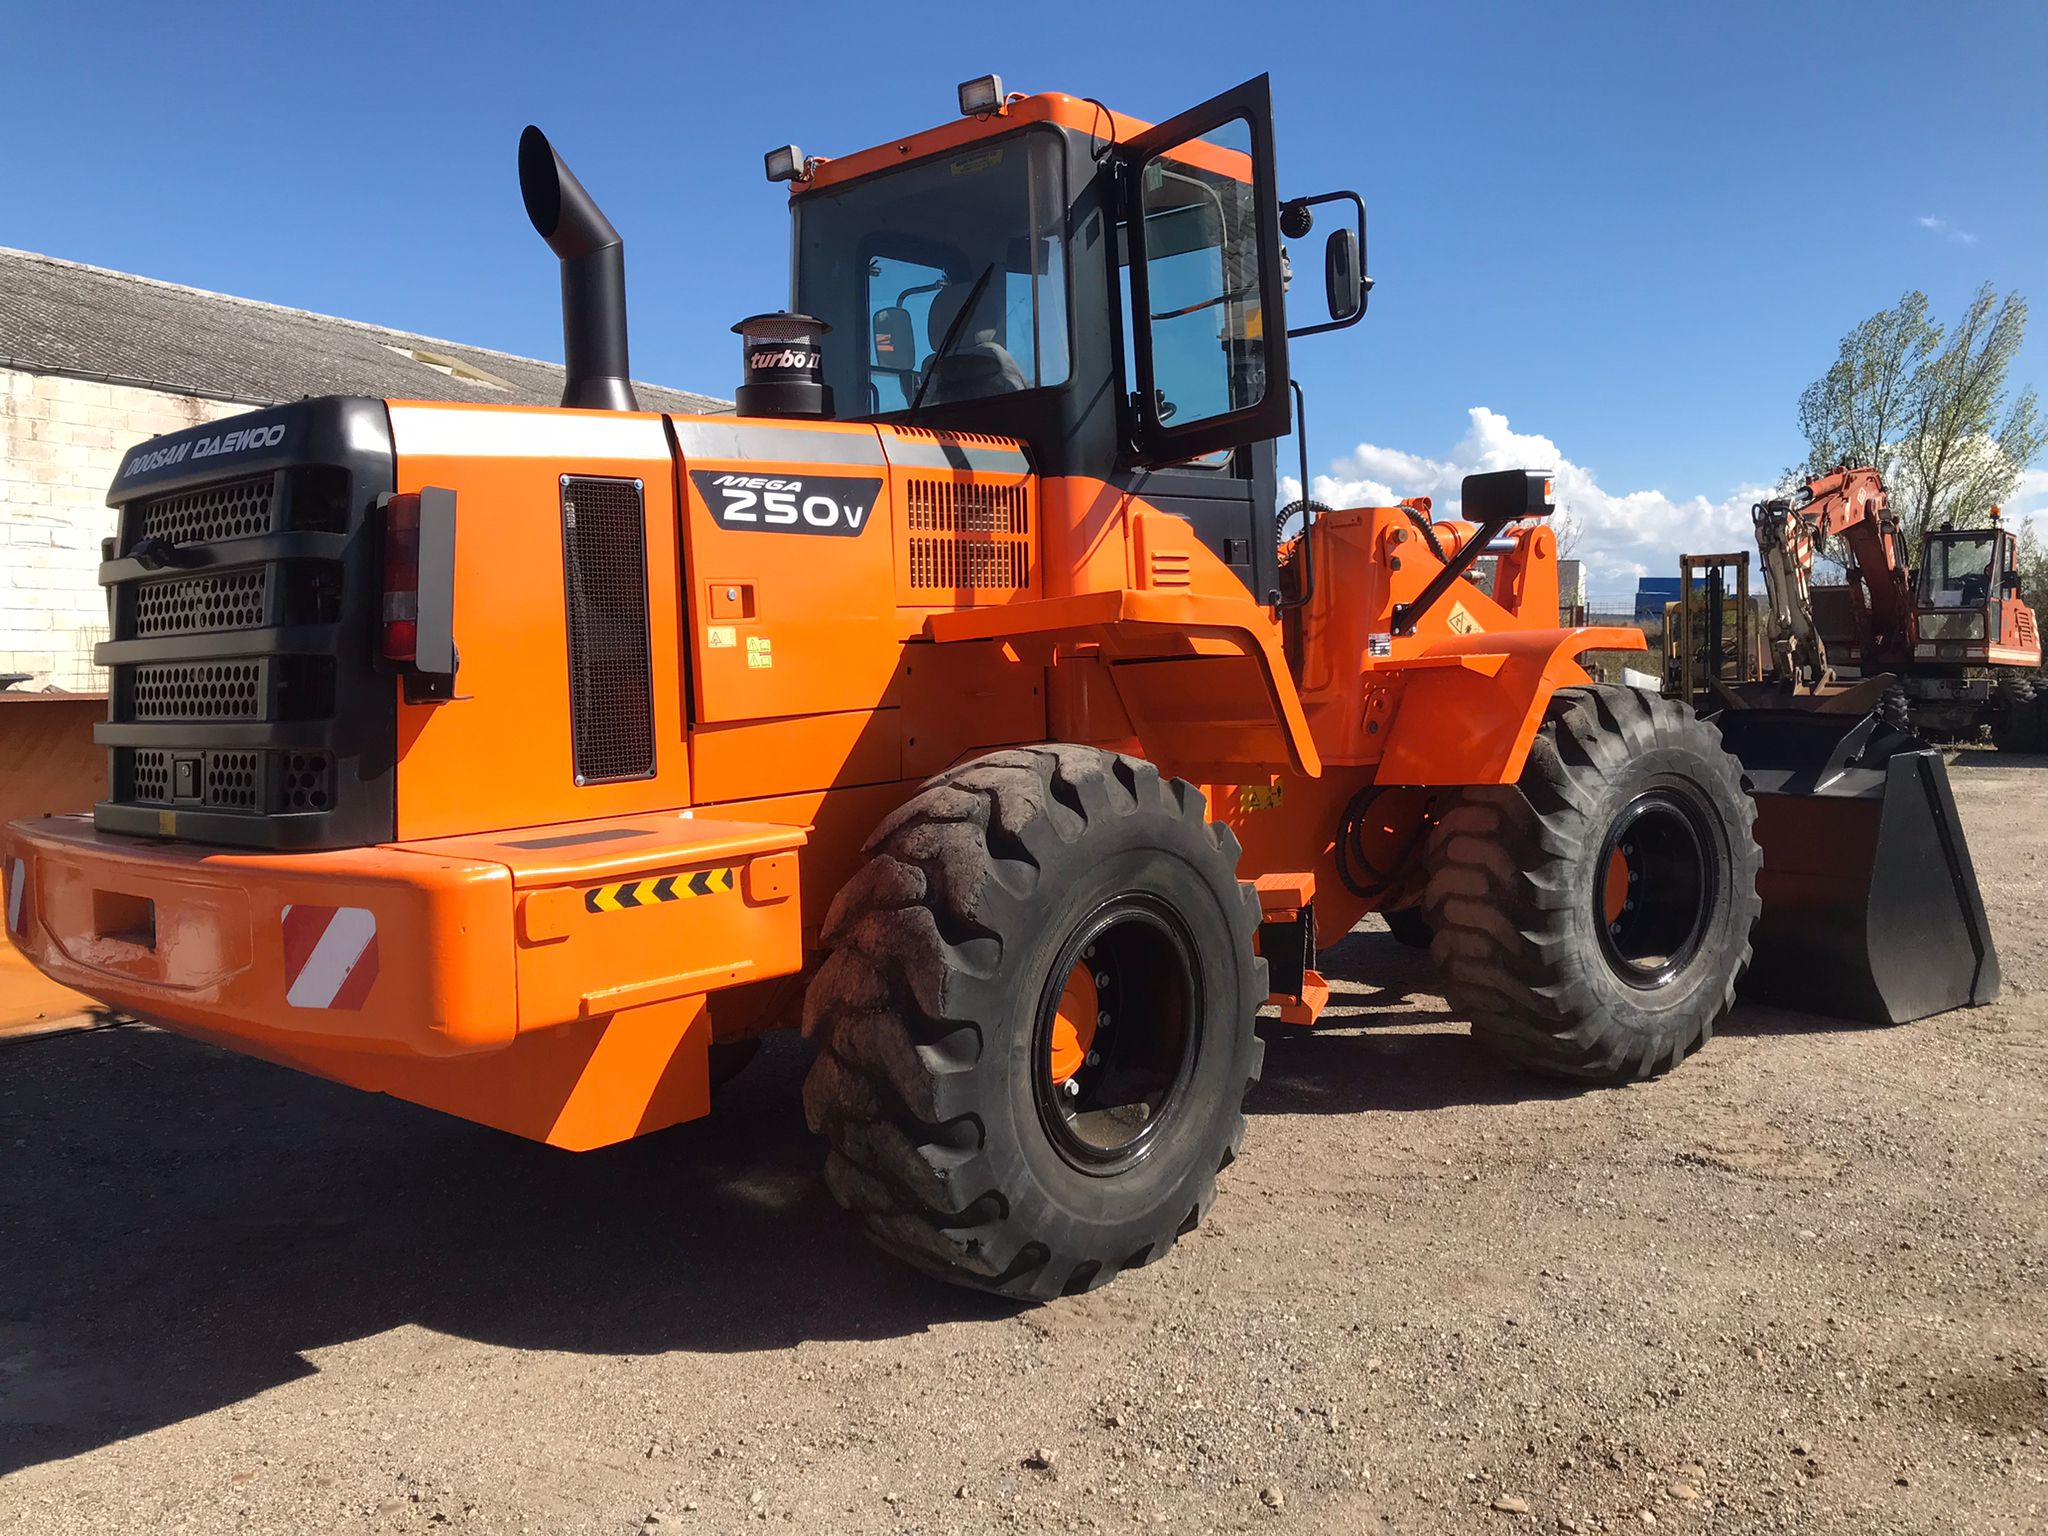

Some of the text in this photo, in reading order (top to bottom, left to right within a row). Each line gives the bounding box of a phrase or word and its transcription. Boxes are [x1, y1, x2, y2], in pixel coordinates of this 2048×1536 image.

[751, 349, 806, 369] turbo
[123, 424, 286, 478] DOOSAN DAEWOO
[712, 475, 803, 492] MEGA
